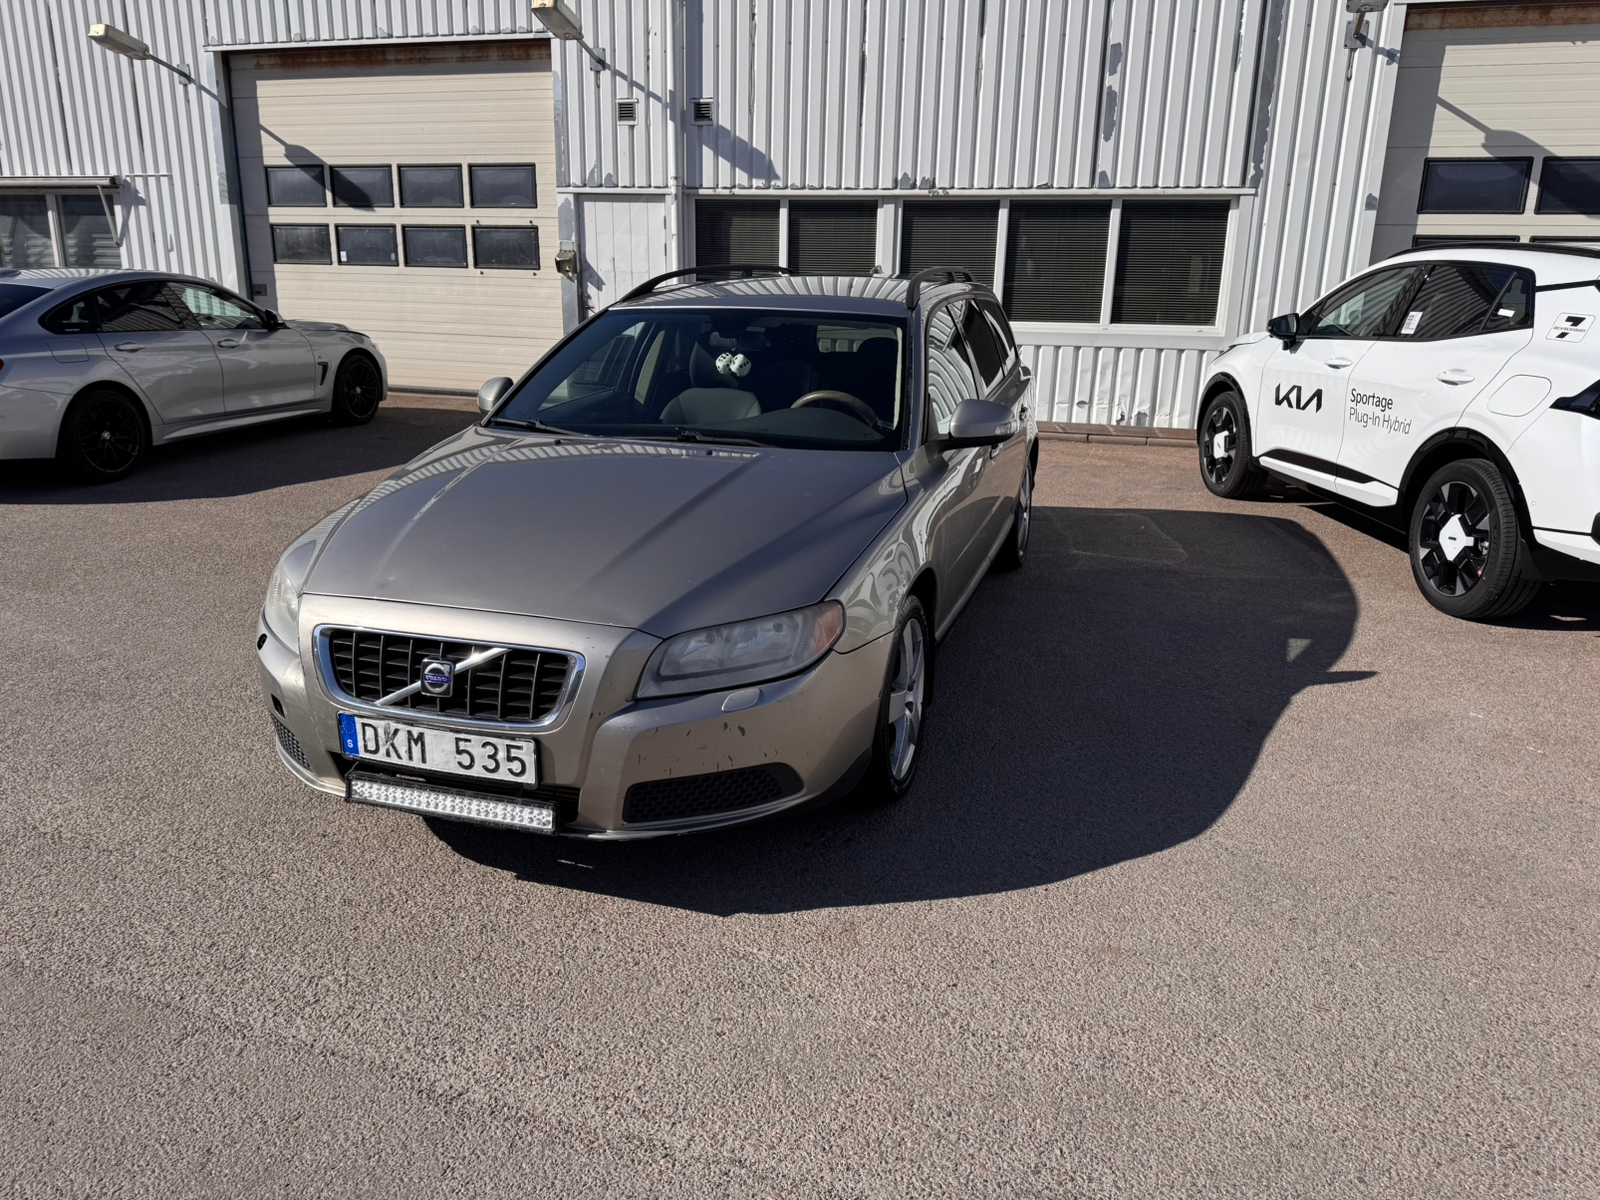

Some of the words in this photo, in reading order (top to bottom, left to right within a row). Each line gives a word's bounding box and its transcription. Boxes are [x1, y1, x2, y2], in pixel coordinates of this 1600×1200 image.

[1274, 383, 1323, 414] KIA
[1350, 388, 1394, 412] Sportage
[1349, 407, 1381, 428] Plug-In
[1382, 413, 1412, 435] Hybrid
[425, 674, 448, 682] VOLVO
[347, 739, 354, 749] S
[361, 722, 427, 764] DKM
[454, 736, 527, 777] 535
